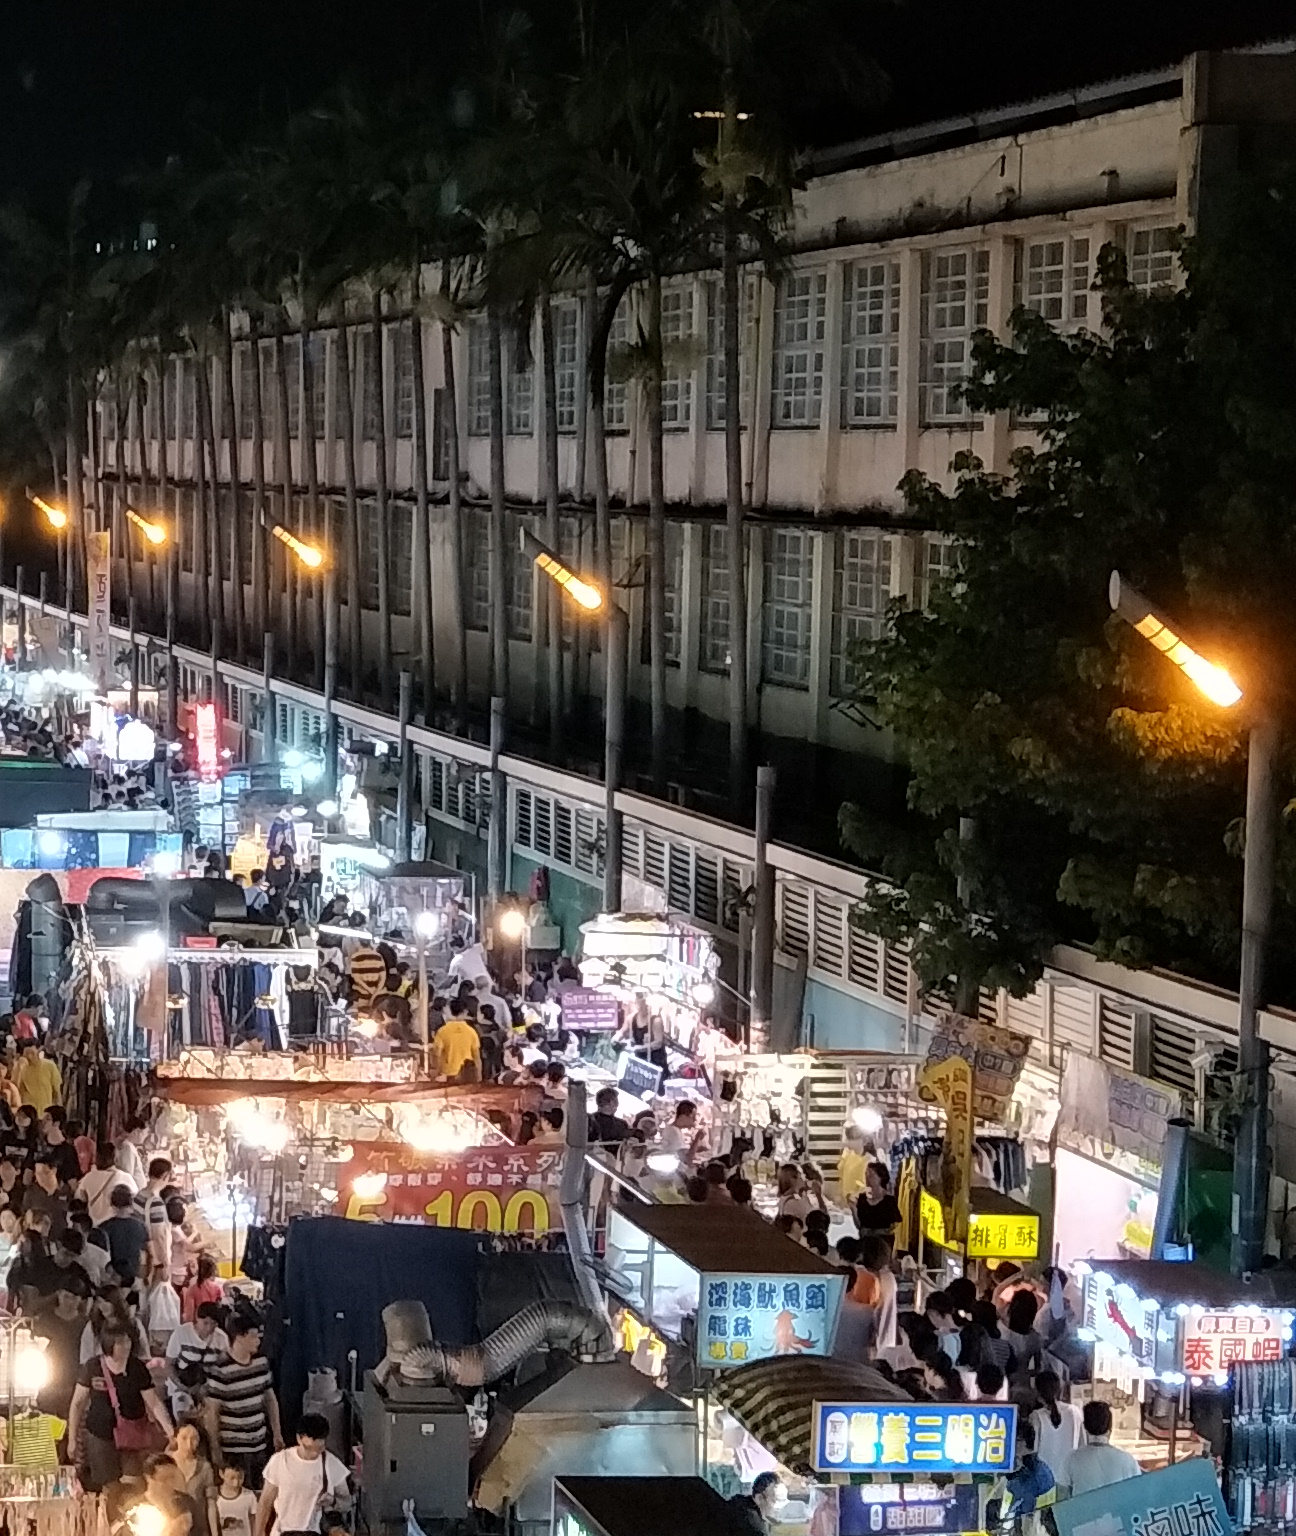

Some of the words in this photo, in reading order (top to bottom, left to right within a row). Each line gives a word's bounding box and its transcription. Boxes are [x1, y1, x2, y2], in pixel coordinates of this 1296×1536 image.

[425, 1188, 550, 1235] 100
[971, 1224, 1037, 1250] 排骨酥
[707, 1280, 826, 1310] 深海魷魚頭
[707, 1314, 753, 1337] 龍珠
[1184, 1337, 1281, 1370] 泰國蝦
[849, 1411, 1007, 1464] 營養三明治
